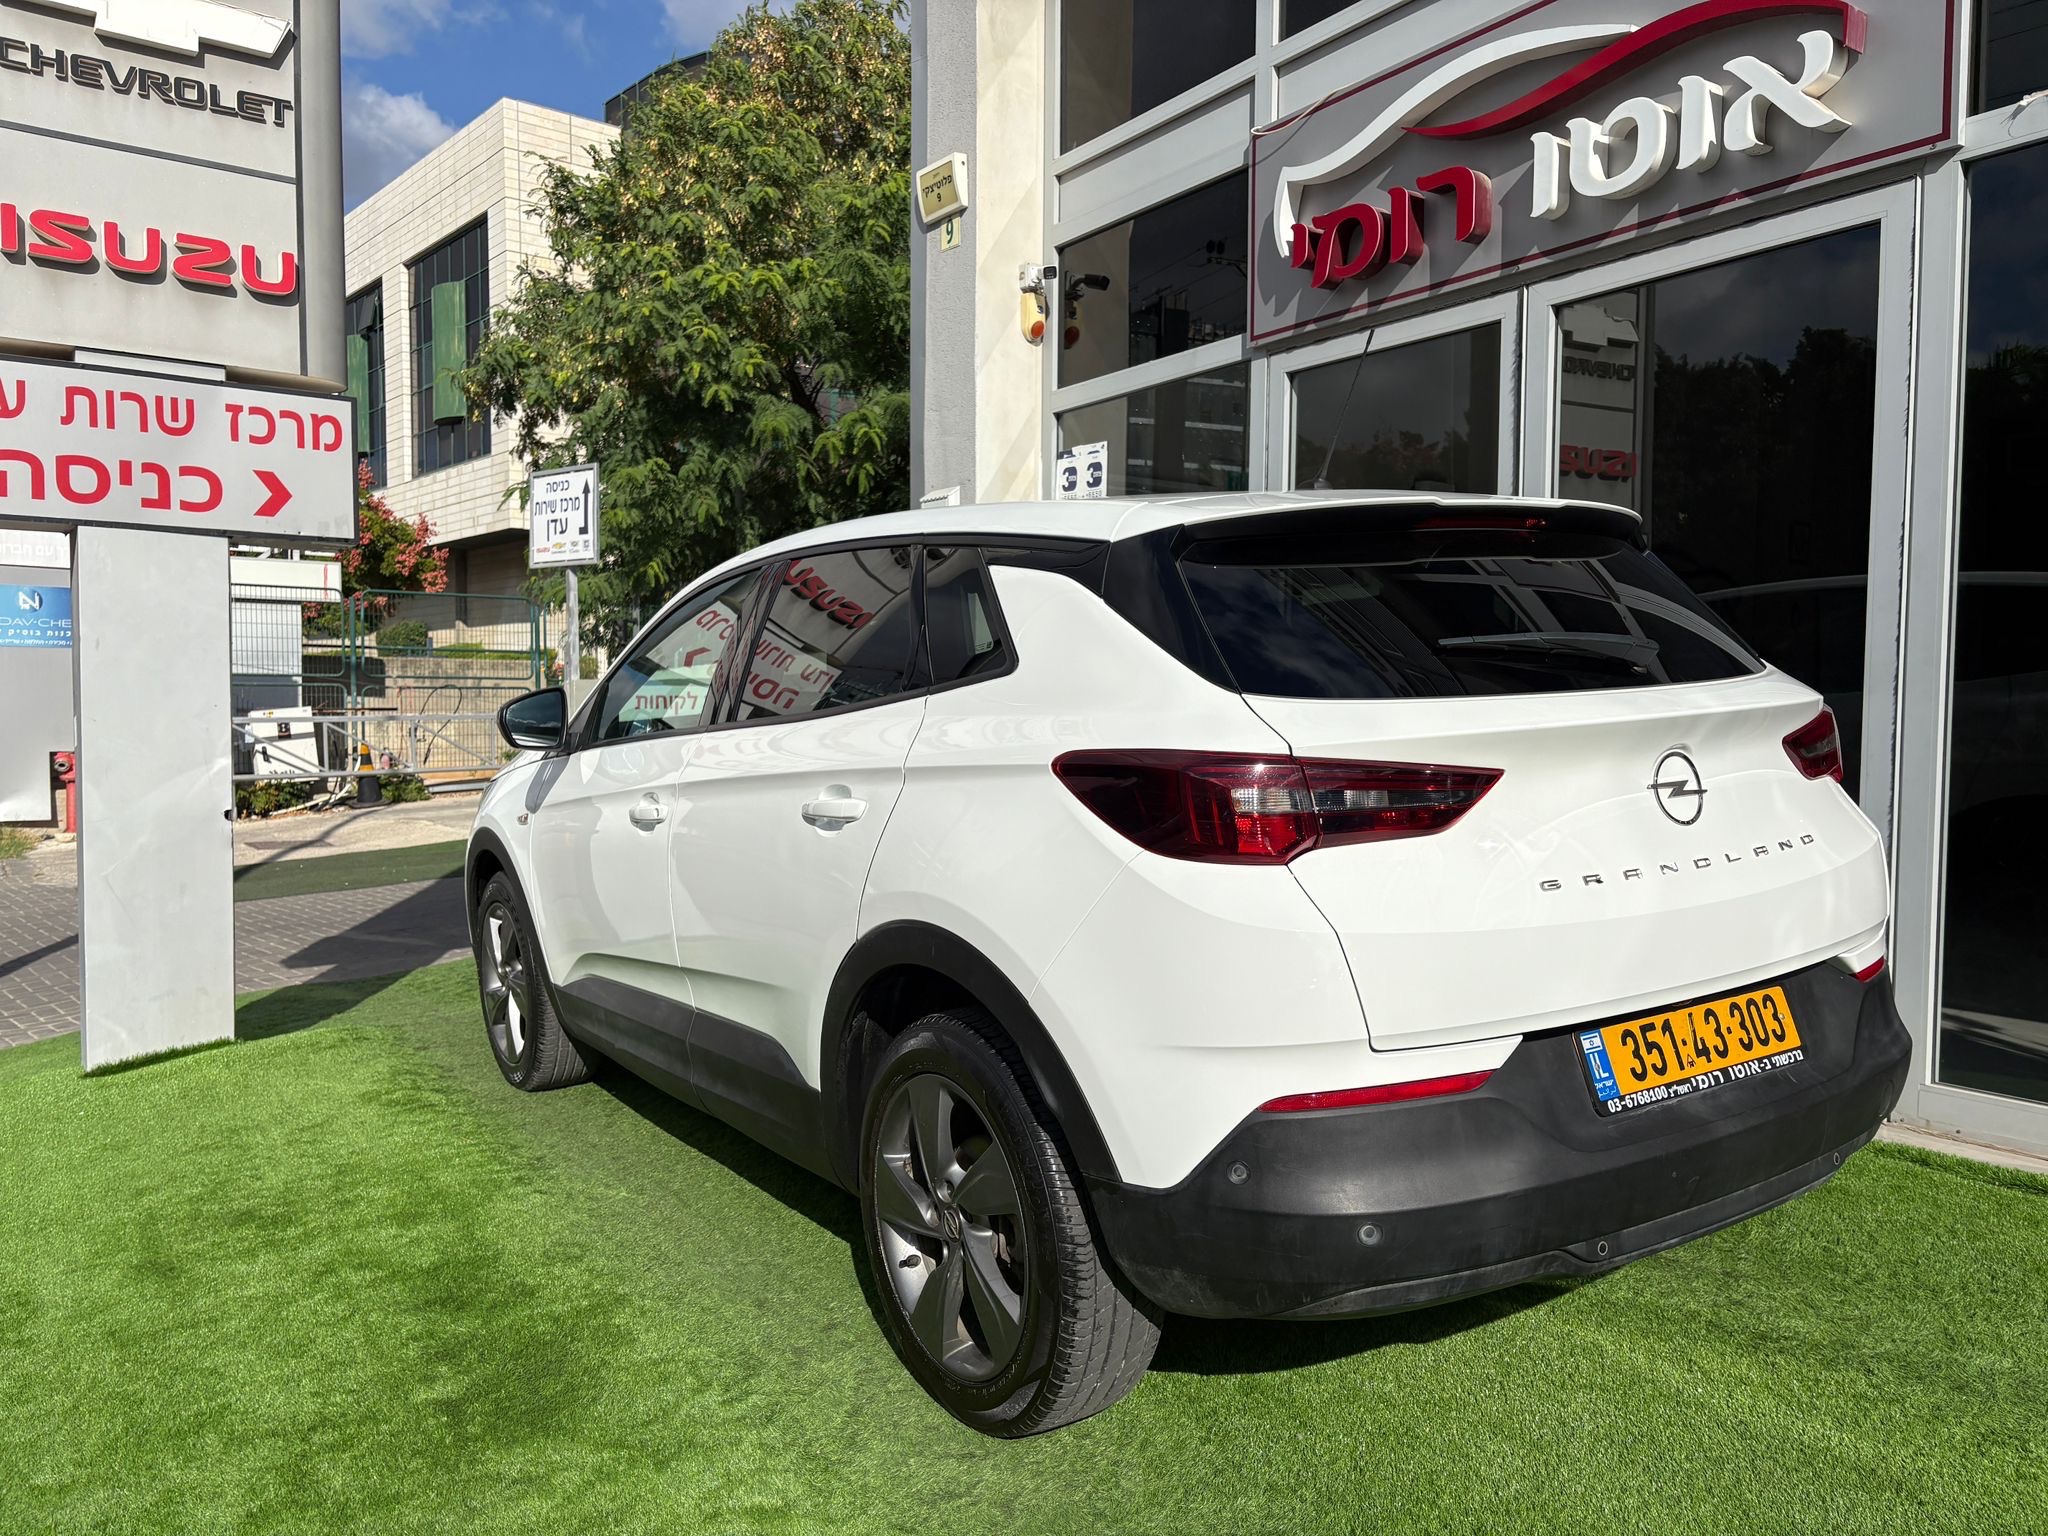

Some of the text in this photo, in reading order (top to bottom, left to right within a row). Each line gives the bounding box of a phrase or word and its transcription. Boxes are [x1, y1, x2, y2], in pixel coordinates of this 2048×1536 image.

[0, 37, 294, 126] CHEVROLET
[1291, 30, 1853, 289] אוטו רומי
[936, 192, 942, 203] 9
[0, 203, 297, 296] ISUZU
[945, 217, 954, 245] 9
[60, 384, 195, 437] שרות
[225, 403, 343, 453] מרכז
[0, 449, 224, 513] כניסה
[546, 480, 570, 493] כניסה
[534, 496, 581, 516] מרכז שירות
[547, 517, 569, 542] עדן
[1539, 834, 1815, 892] GRANDLAND
[1589, 1052, 1610, 1079] IL
[1691, 1070, 1725, 1090] רומי
